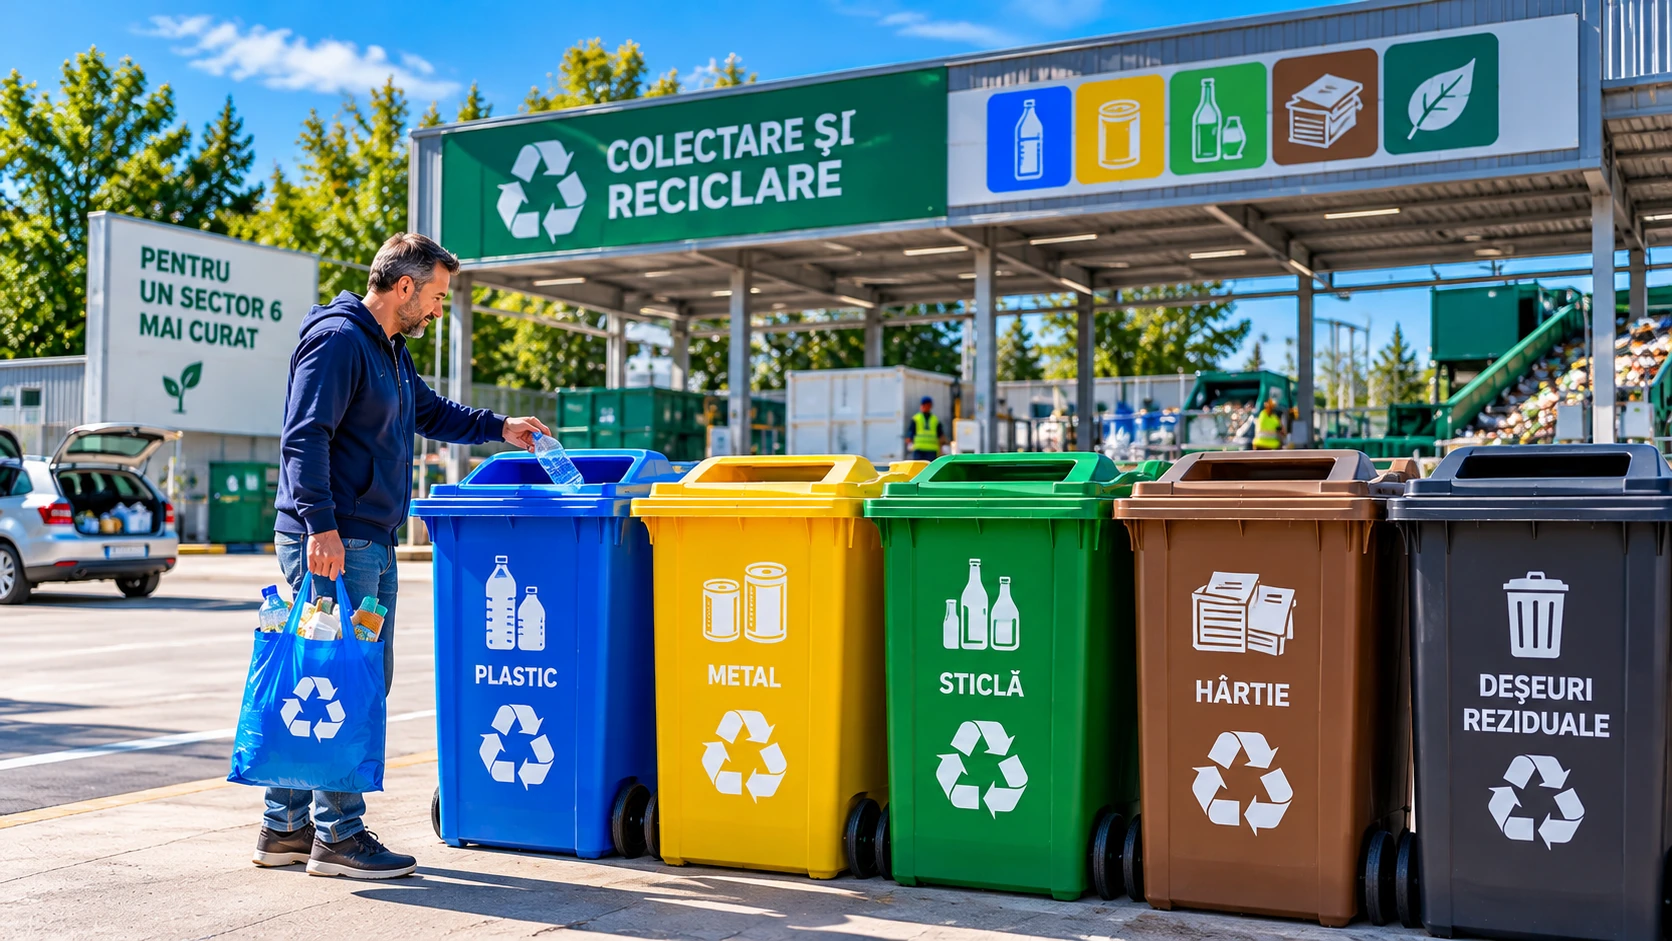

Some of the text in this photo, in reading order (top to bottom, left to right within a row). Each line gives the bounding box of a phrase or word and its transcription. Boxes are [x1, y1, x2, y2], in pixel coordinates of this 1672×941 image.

[606, 117, 805, 174] COLECTARE
[608, 159, 842, 220] RECICLARE
[140, 245, 231, 283] PENTRU
[139, 278, 283, 323] UN SECTOR 6
[139, 312, 260, 350] MAI CURAT
[475, 664, 558, 688] PLASTIC
[708, 664, 782, 688] METAL
[939, 670, 1025, 698] STICLĂ
[1196, 674, 1290, 707] HÂRTIE
[1463, 708, 1611, 738] REZIDUALE
